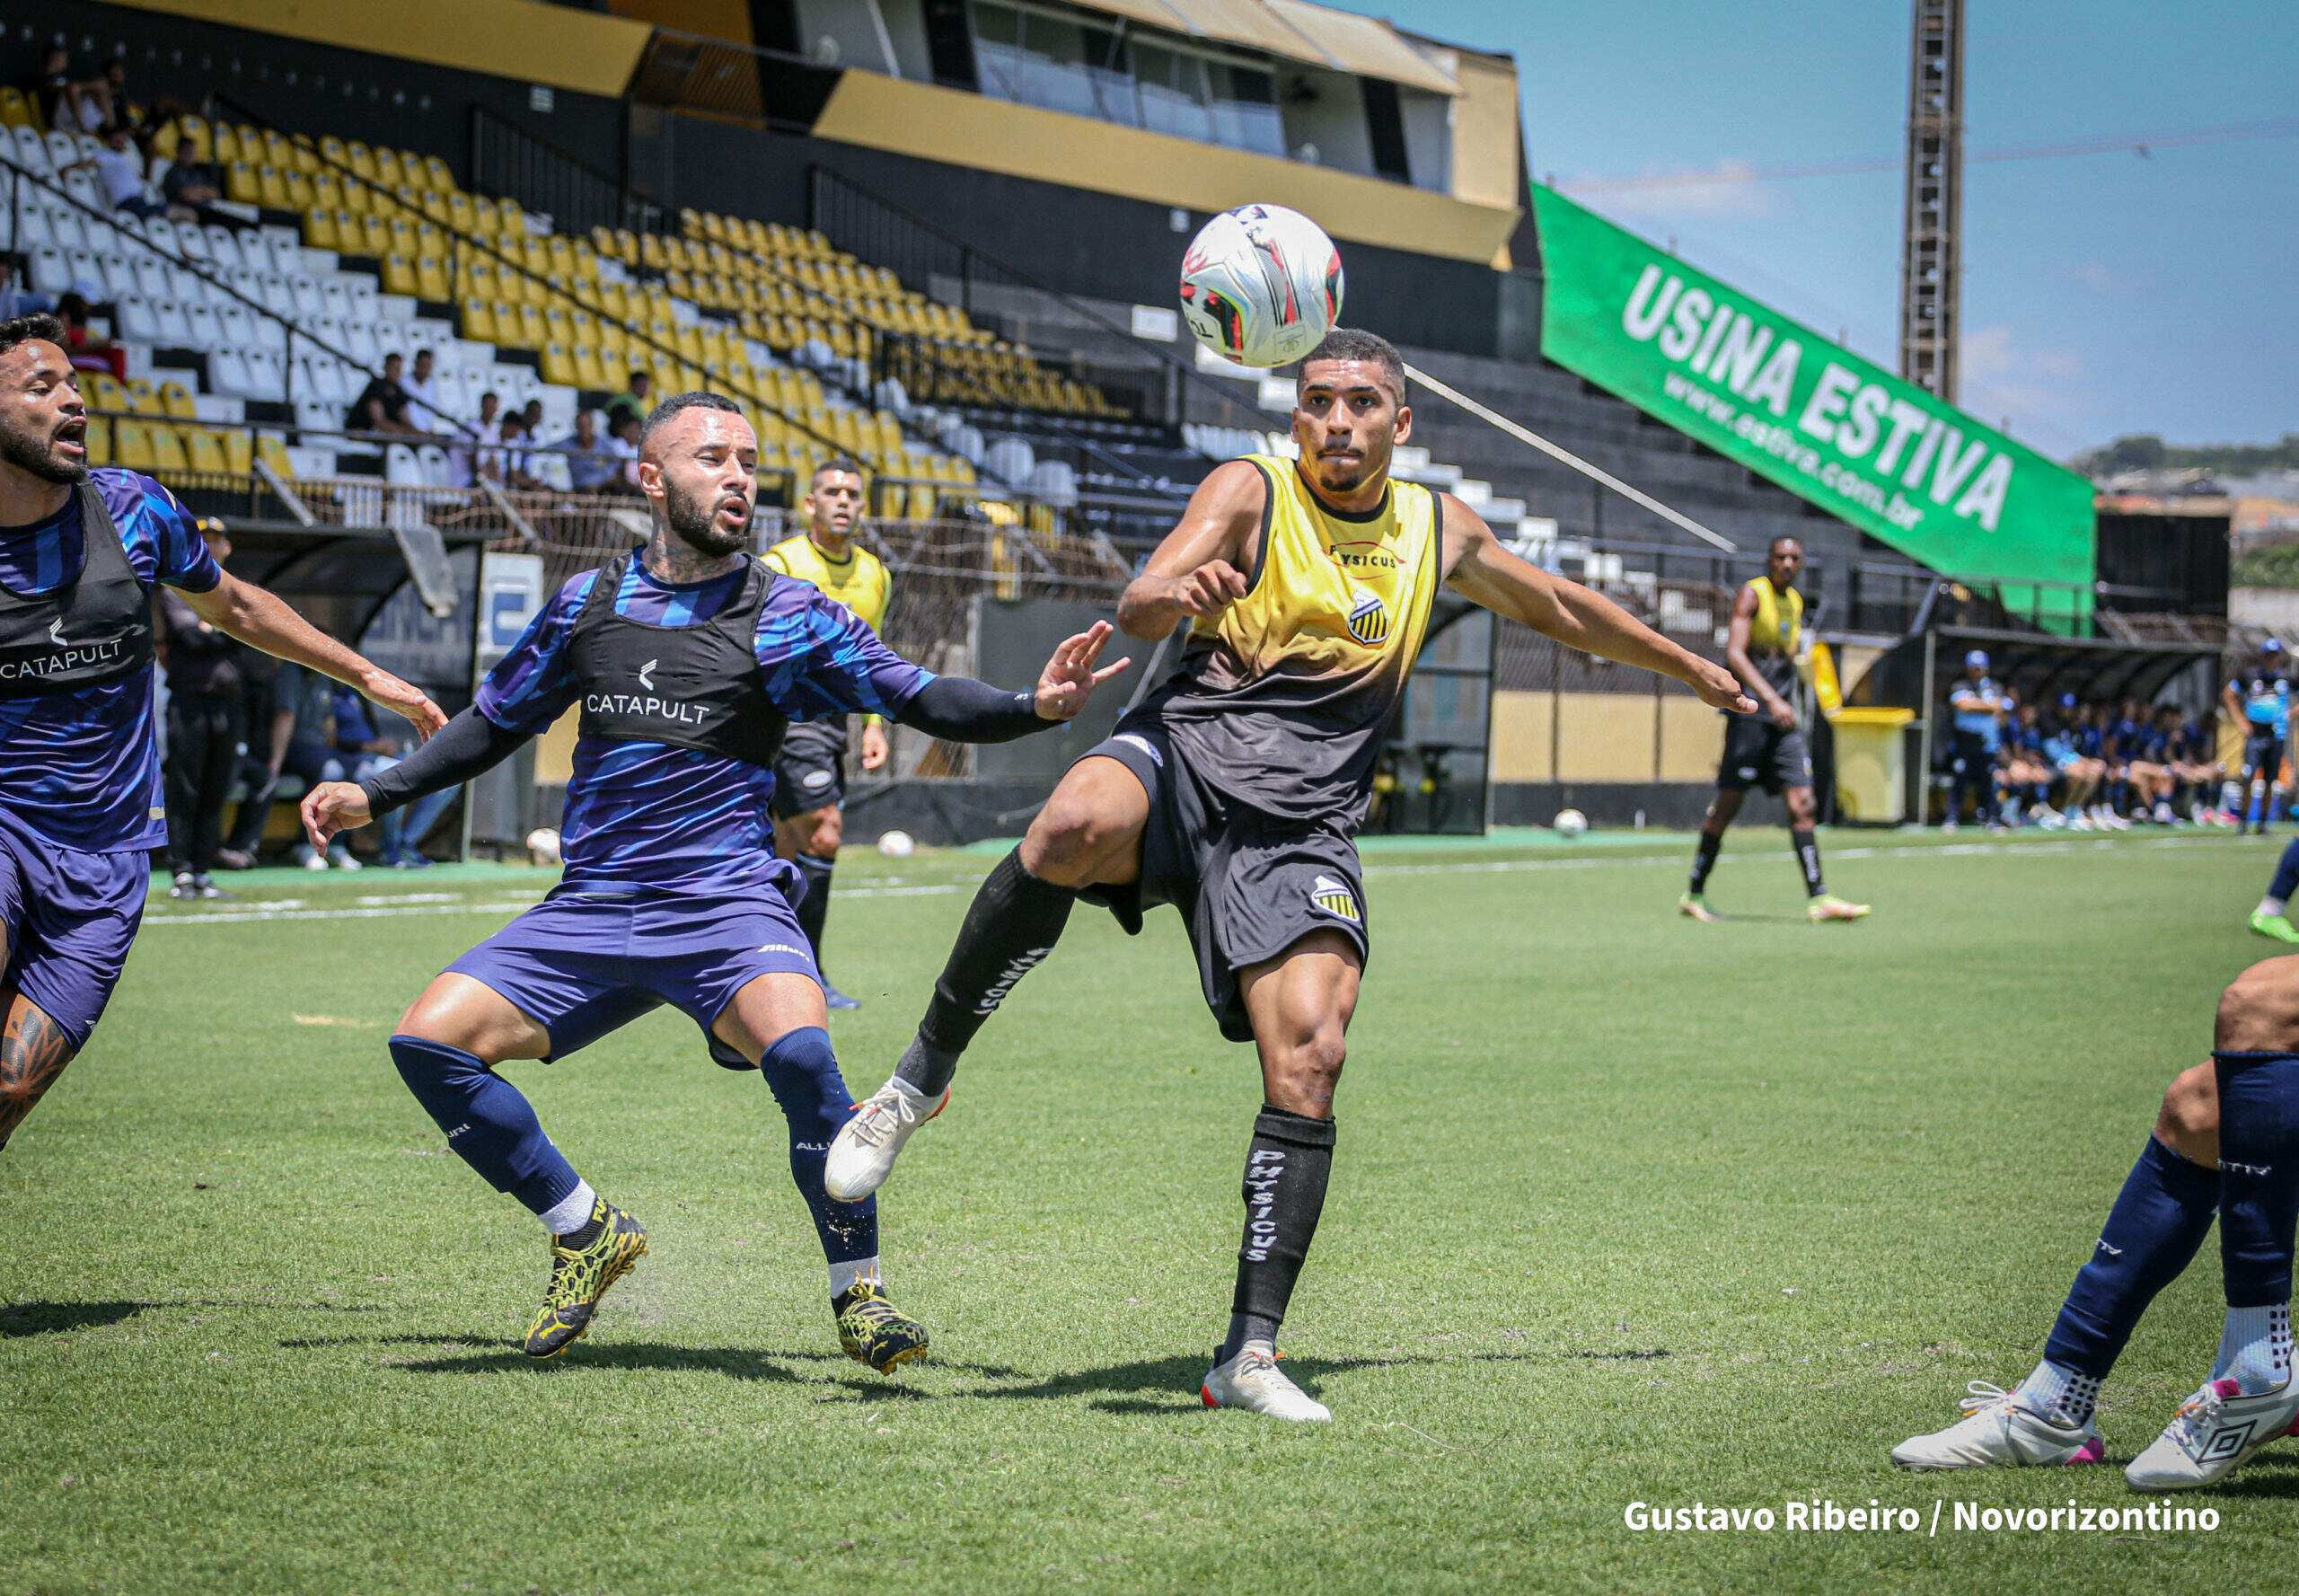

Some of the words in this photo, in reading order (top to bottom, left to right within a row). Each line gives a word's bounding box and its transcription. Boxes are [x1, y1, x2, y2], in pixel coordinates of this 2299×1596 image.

[1622, 264, 1801, 418] USINA
[1798, 362, 2013, 533] ESTIVA
[1329, 544, 1396, 569] PYSICUS
[0, 638, 122, 679] CATAPULT
[586, 693, 710, 725] CATAPULT
[1245, 1149, 1286, 1262] PHYSICUS
